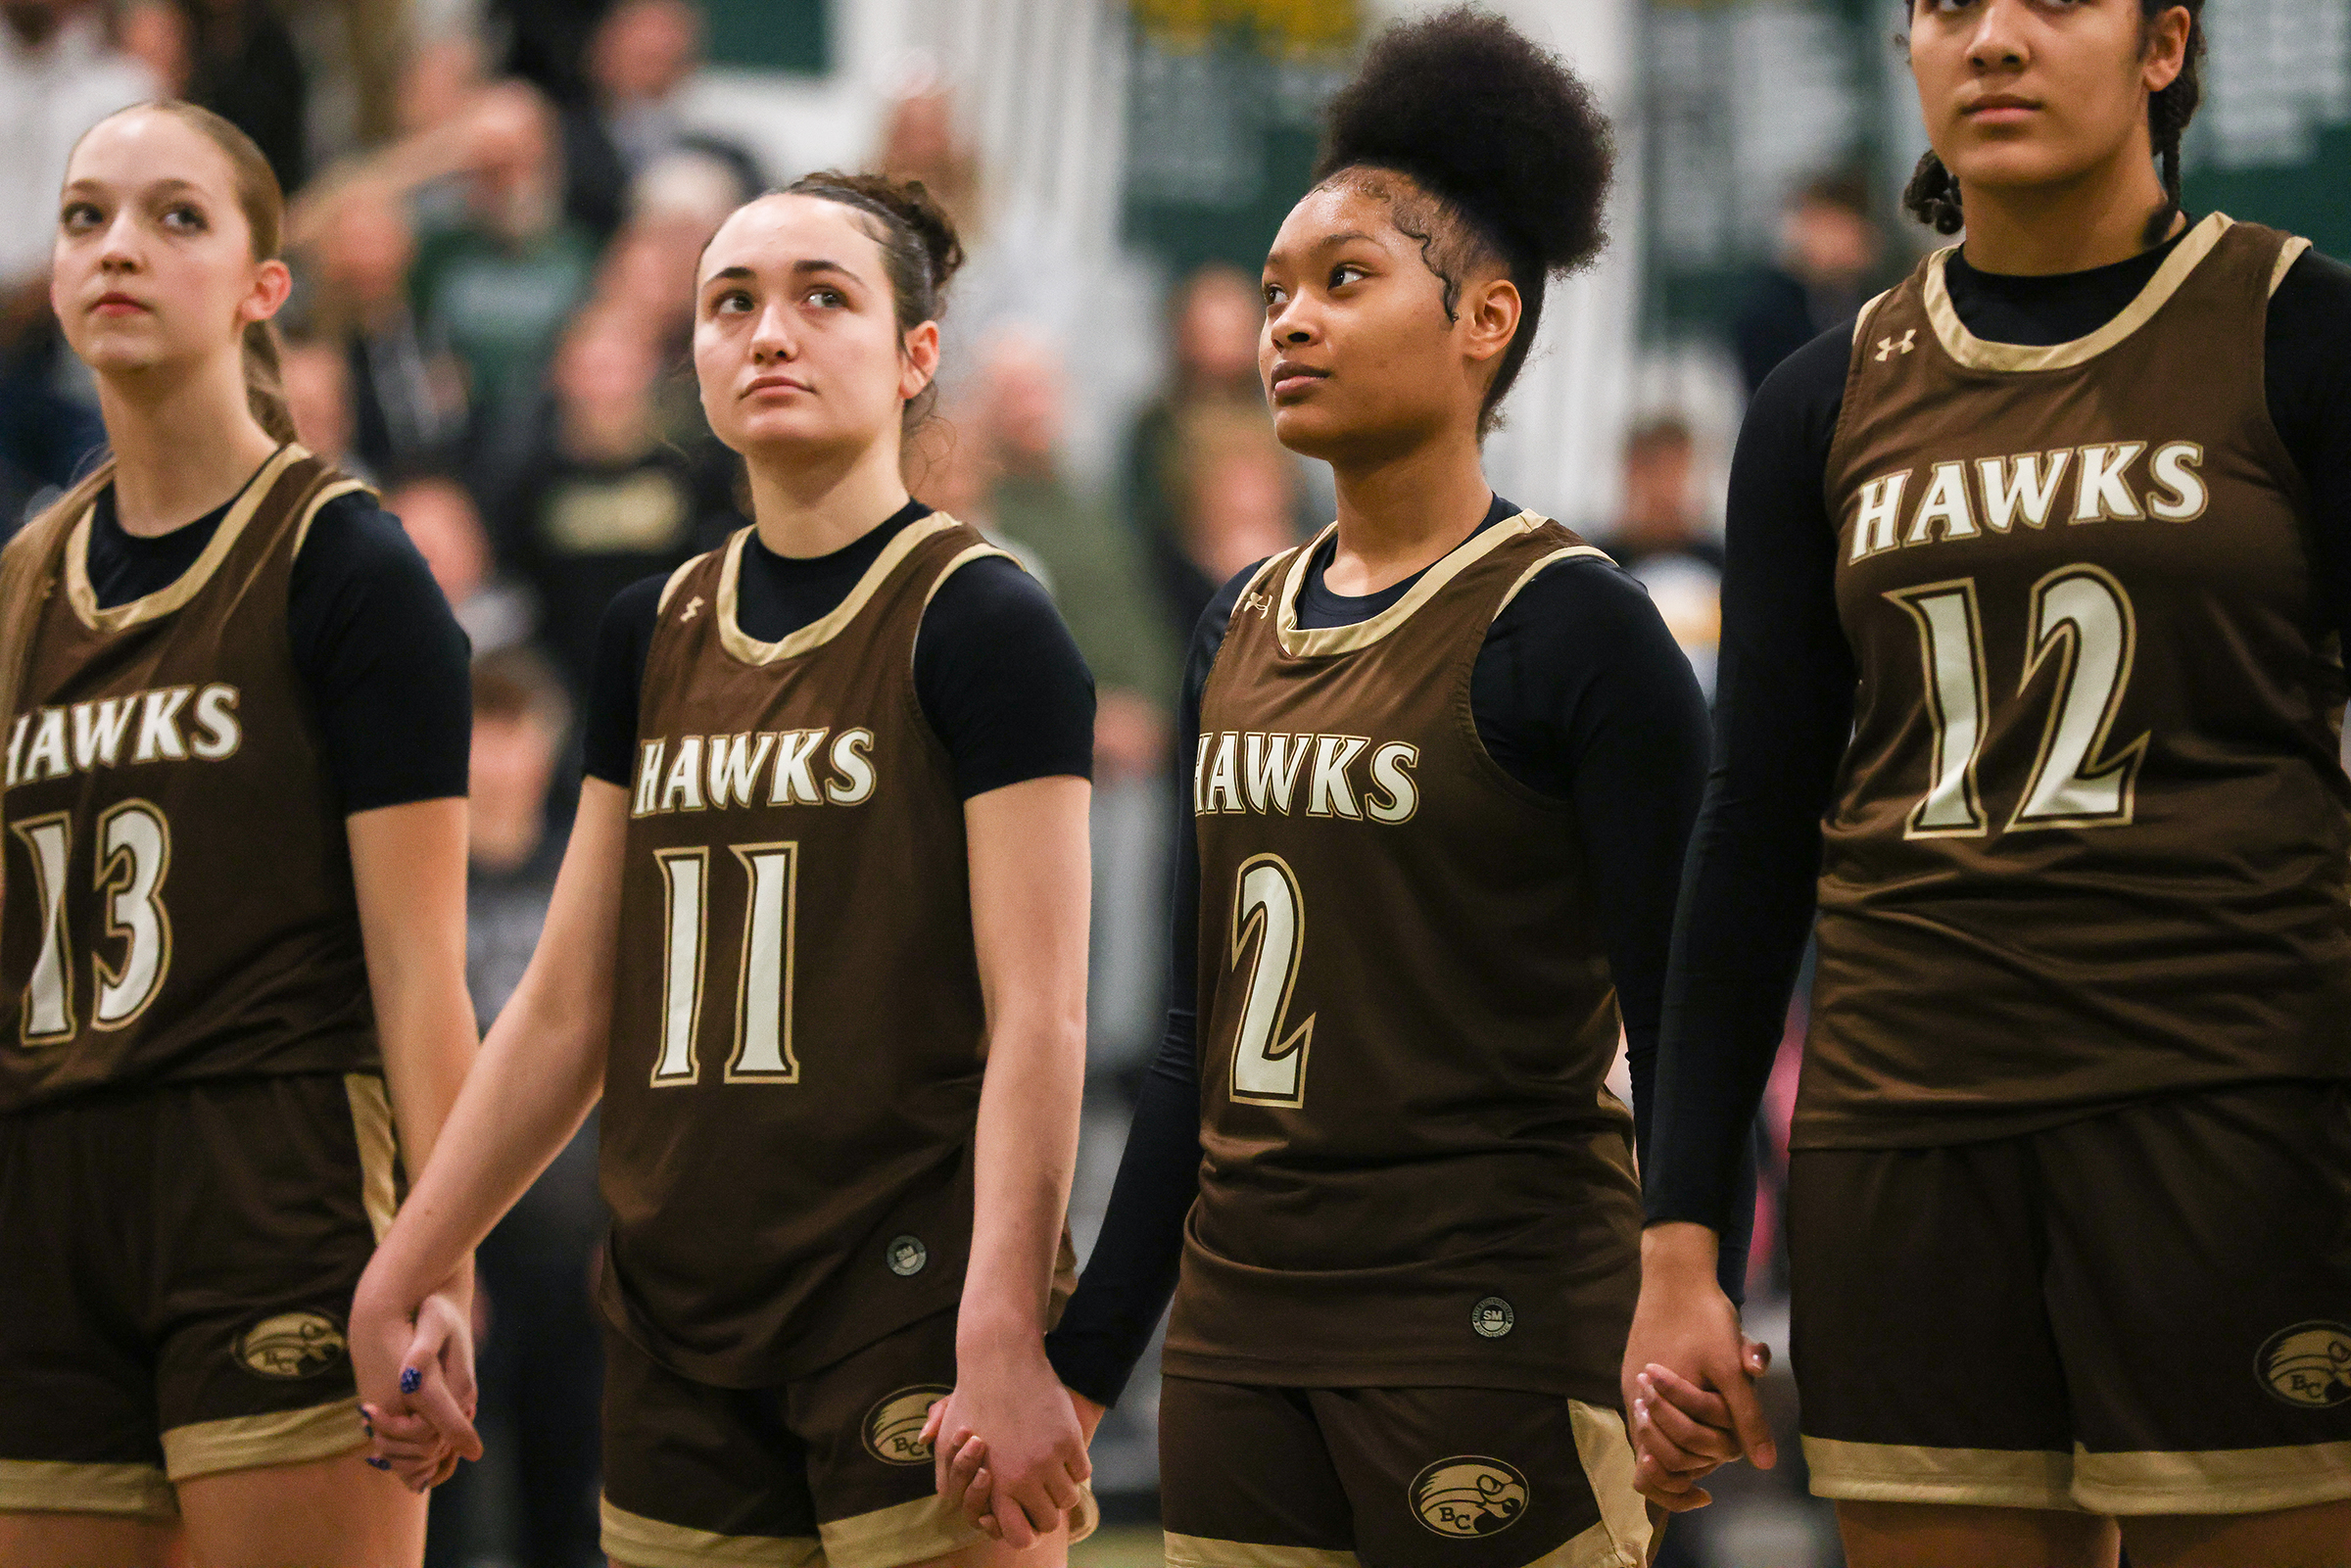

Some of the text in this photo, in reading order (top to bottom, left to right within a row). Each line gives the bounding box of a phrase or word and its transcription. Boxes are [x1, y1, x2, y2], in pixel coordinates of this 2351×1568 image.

[1848, 440, 2209, 566] HAWKS
[1882, 562, 2151, 840] 12
[630, 727, 877, 818] HAWKS
[10, 796, 173, 1048] 13
[649, 841, 800, 1088] 11
[1228, 852, 1317, 1110] 2
[1483, 1309, 1504, 1321] SM
[2290, 1374, 2322, 1399] BC
[891, 1437, 924, 1457] BC
[1440, 1506, 1471, 1530] BC
